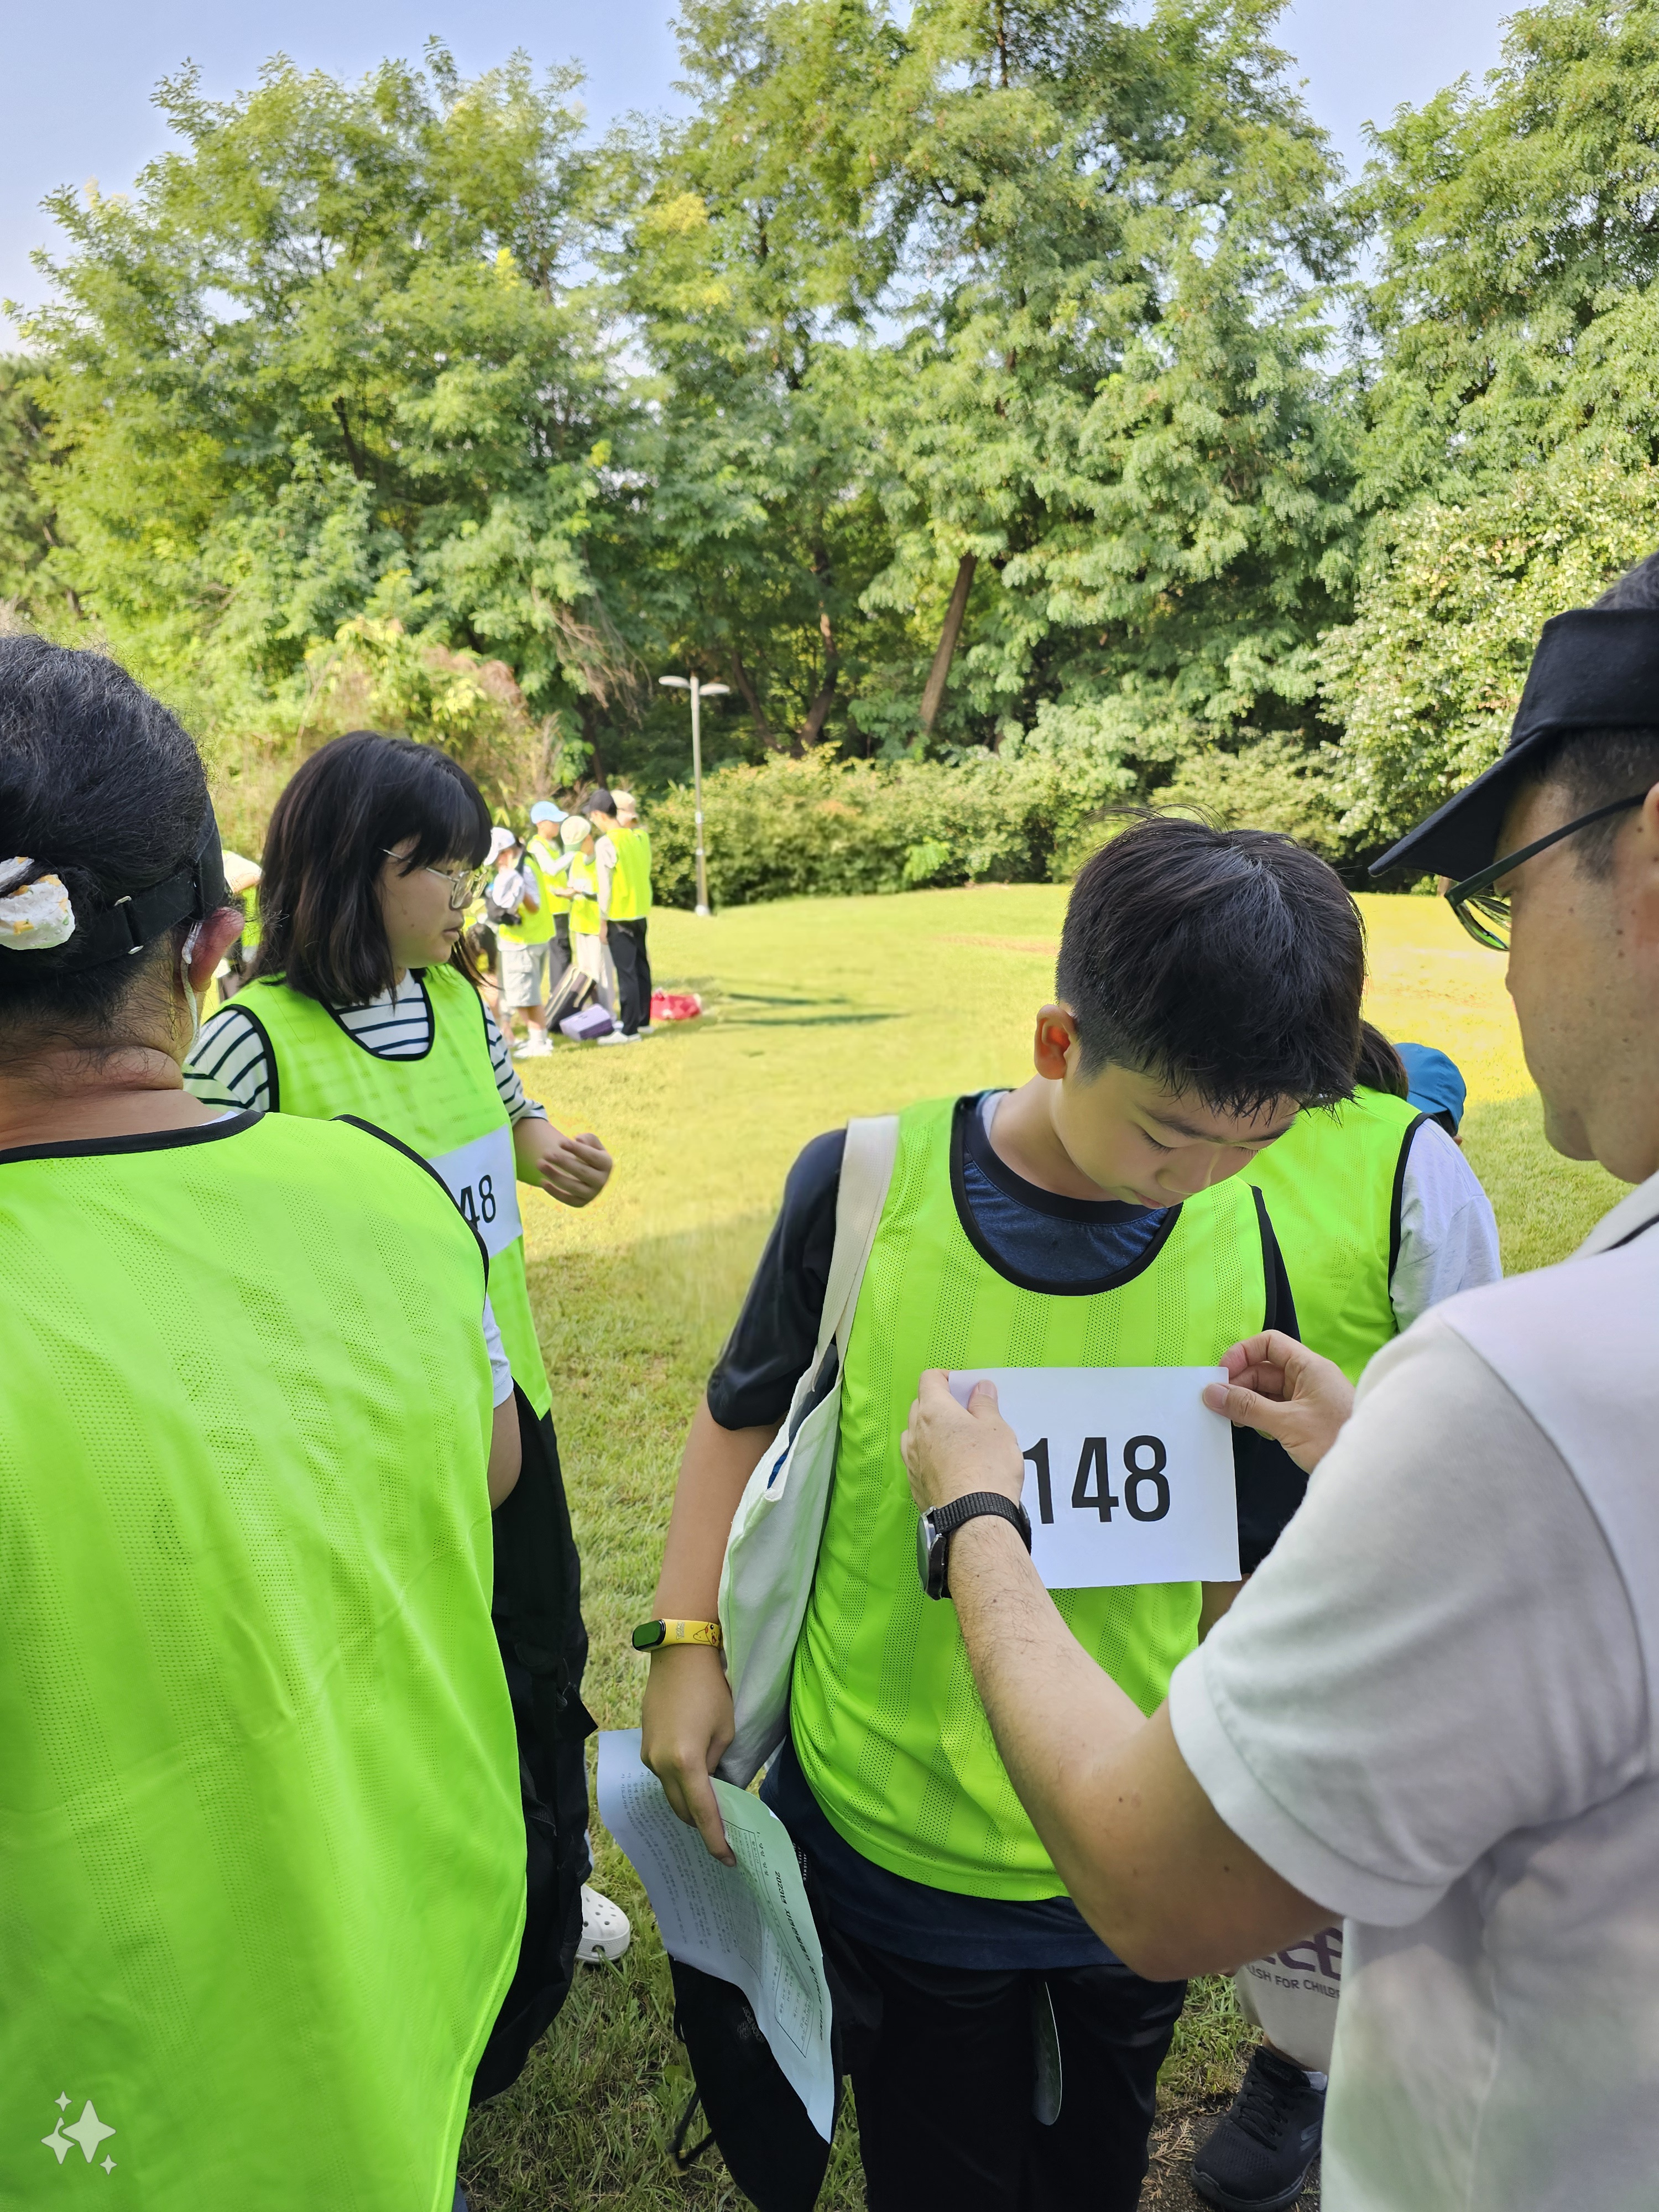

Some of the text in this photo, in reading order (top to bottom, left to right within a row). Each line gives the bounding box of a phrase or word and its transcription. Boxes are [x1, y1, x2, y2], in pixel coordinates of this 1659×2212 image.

[461, 1174, 496, 1229] 48
[1023, 1434, 1170, 1524] 148
[775, 1870, 787, 1905] 2023년
[1275, 1975, 1300, 1989] FOR
